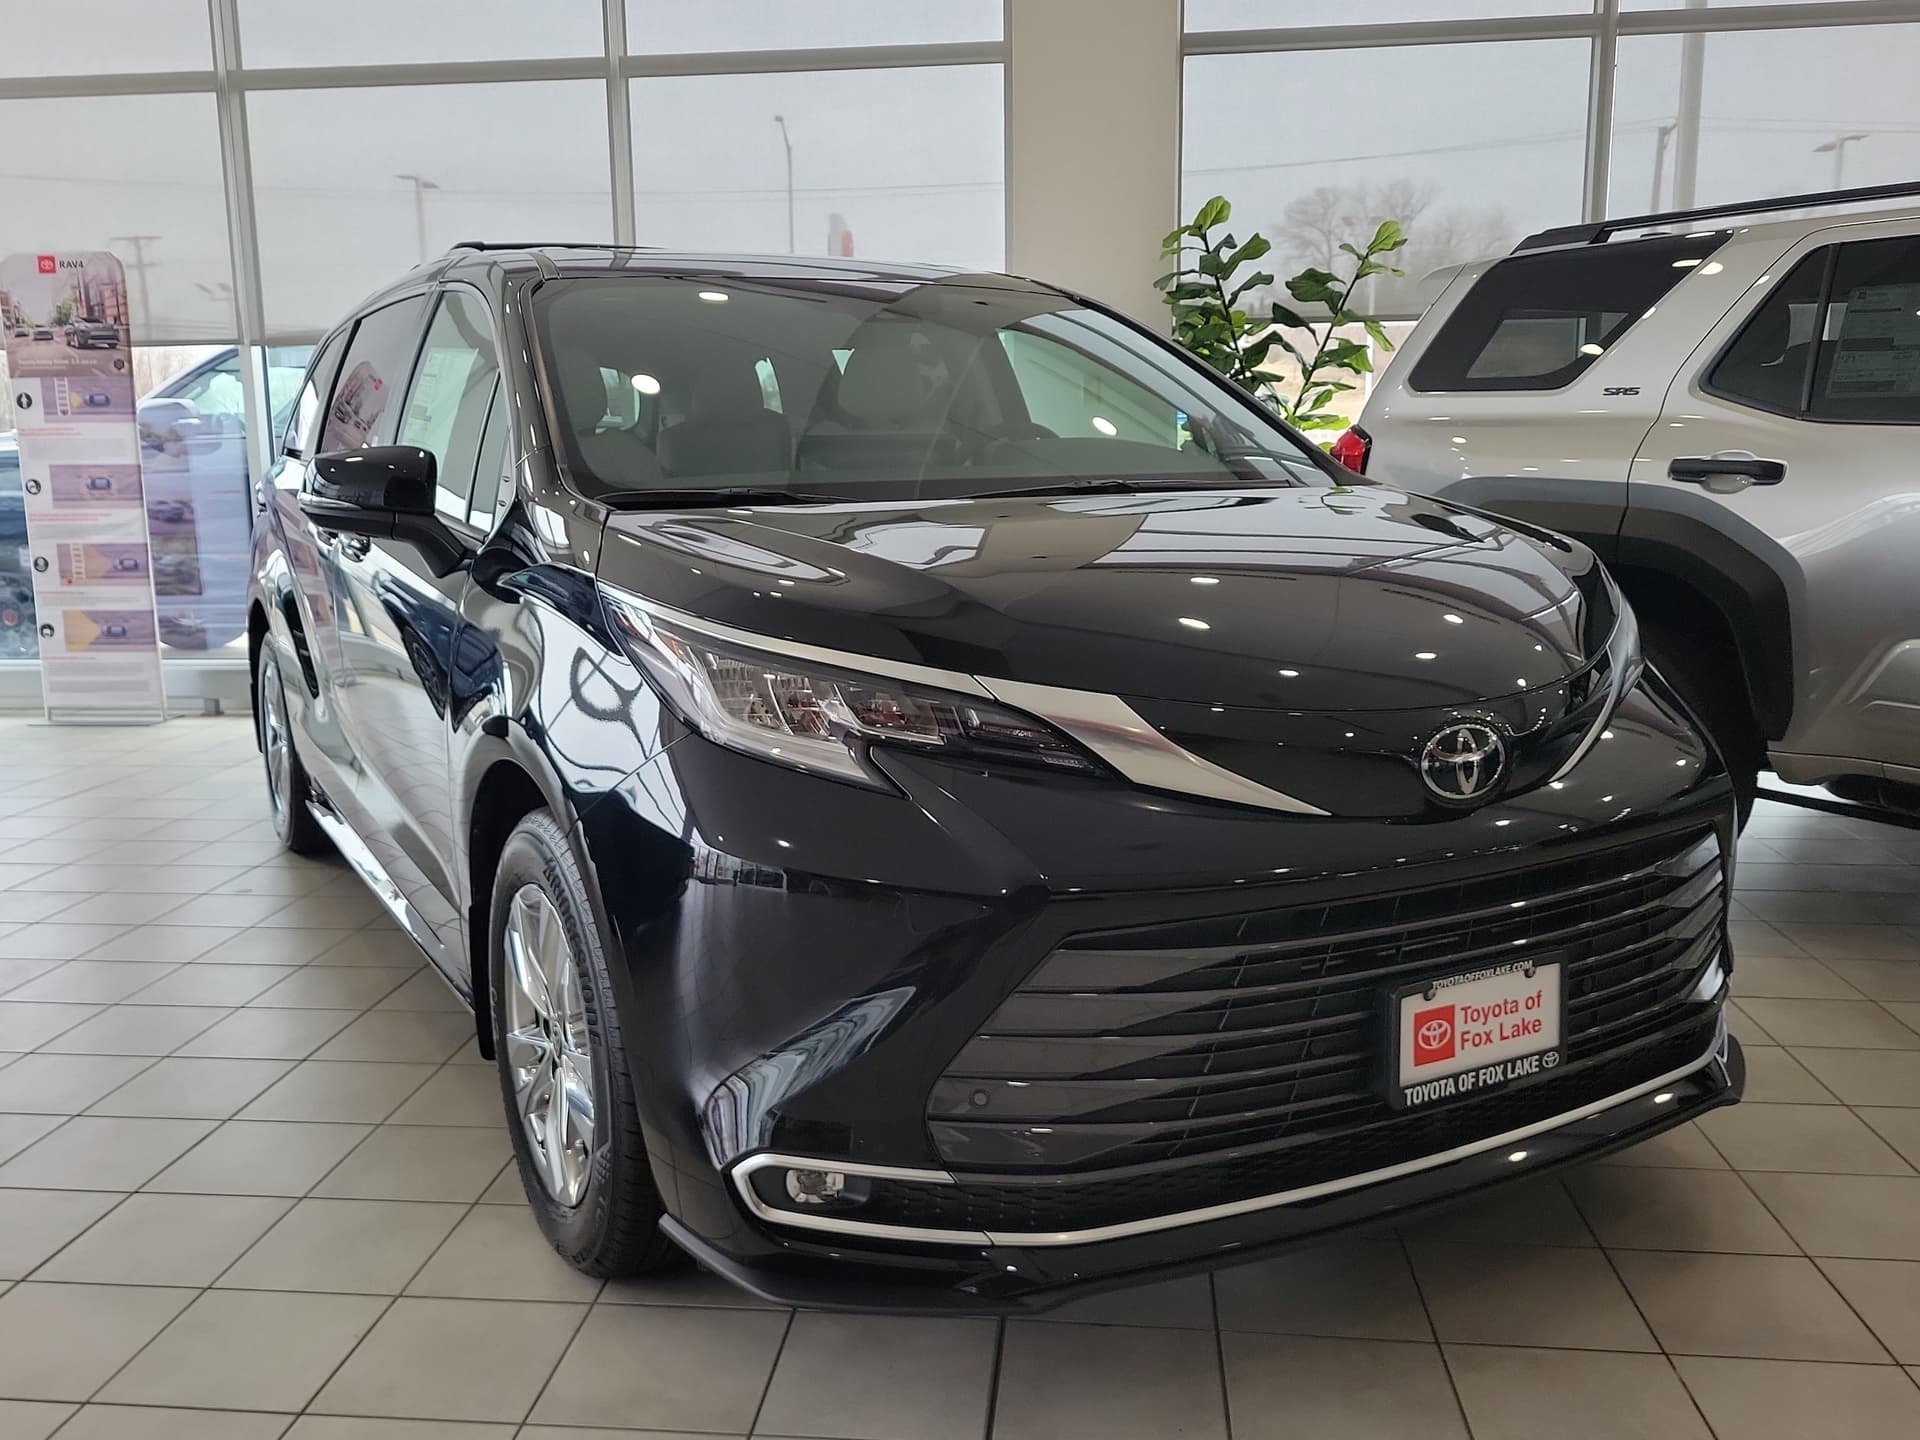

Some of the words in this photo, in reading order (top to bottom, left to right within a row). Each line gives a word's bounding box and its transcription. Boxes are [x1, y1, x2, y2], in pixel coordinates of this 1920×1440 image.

[59, 260, 84, 269] RAV4
[1602, 387, 1641, 396] SR5
[1432, 960, 1533, 990] TOYOTAOFFOXLAKE.COM
[1460, 998, 1519, 1025] Toyota
[1525, 989, 1543, 1010] of
[1461, 1028, 1493, 1051] Fox
[1499, 1017, 1542, 1041] Lake
[1405, 1079, 1456, 1106] TOYOTA
[1458, 1072, 1477, 1092] OF
[1479, 1064, 1506, 1087] FOX
[1507, 1055, 1540, 1080] LAKE
